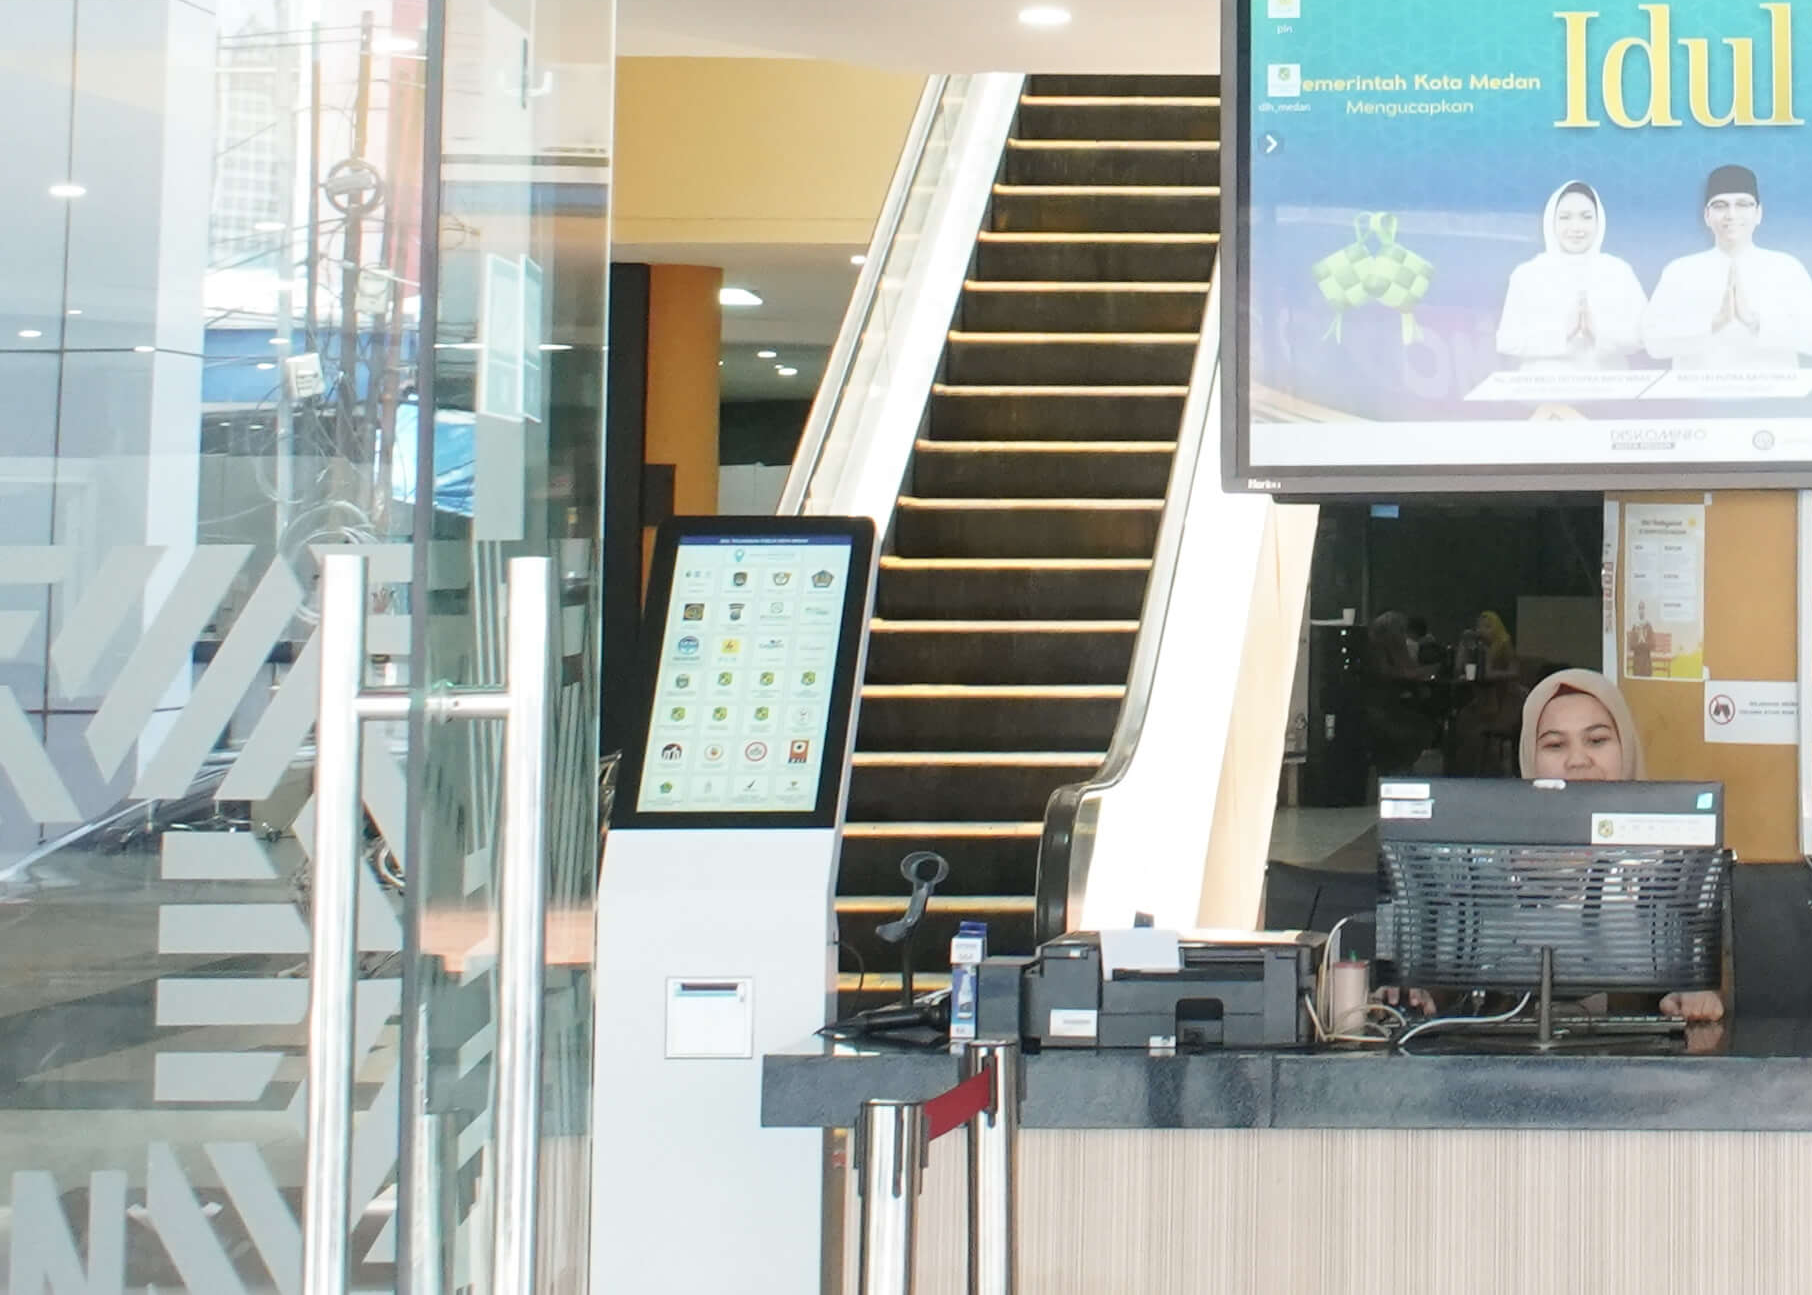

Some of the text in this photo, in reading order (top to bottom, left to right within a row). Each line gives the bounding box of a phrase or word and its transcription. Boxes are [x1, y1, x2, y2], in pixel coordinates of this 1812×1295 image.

[1552, 2, 1806, 130] Idul
[1301, 74, 1541, 92] emerintah Kota Medan
[1345, 99, 1475, 118] Mengucapkan
